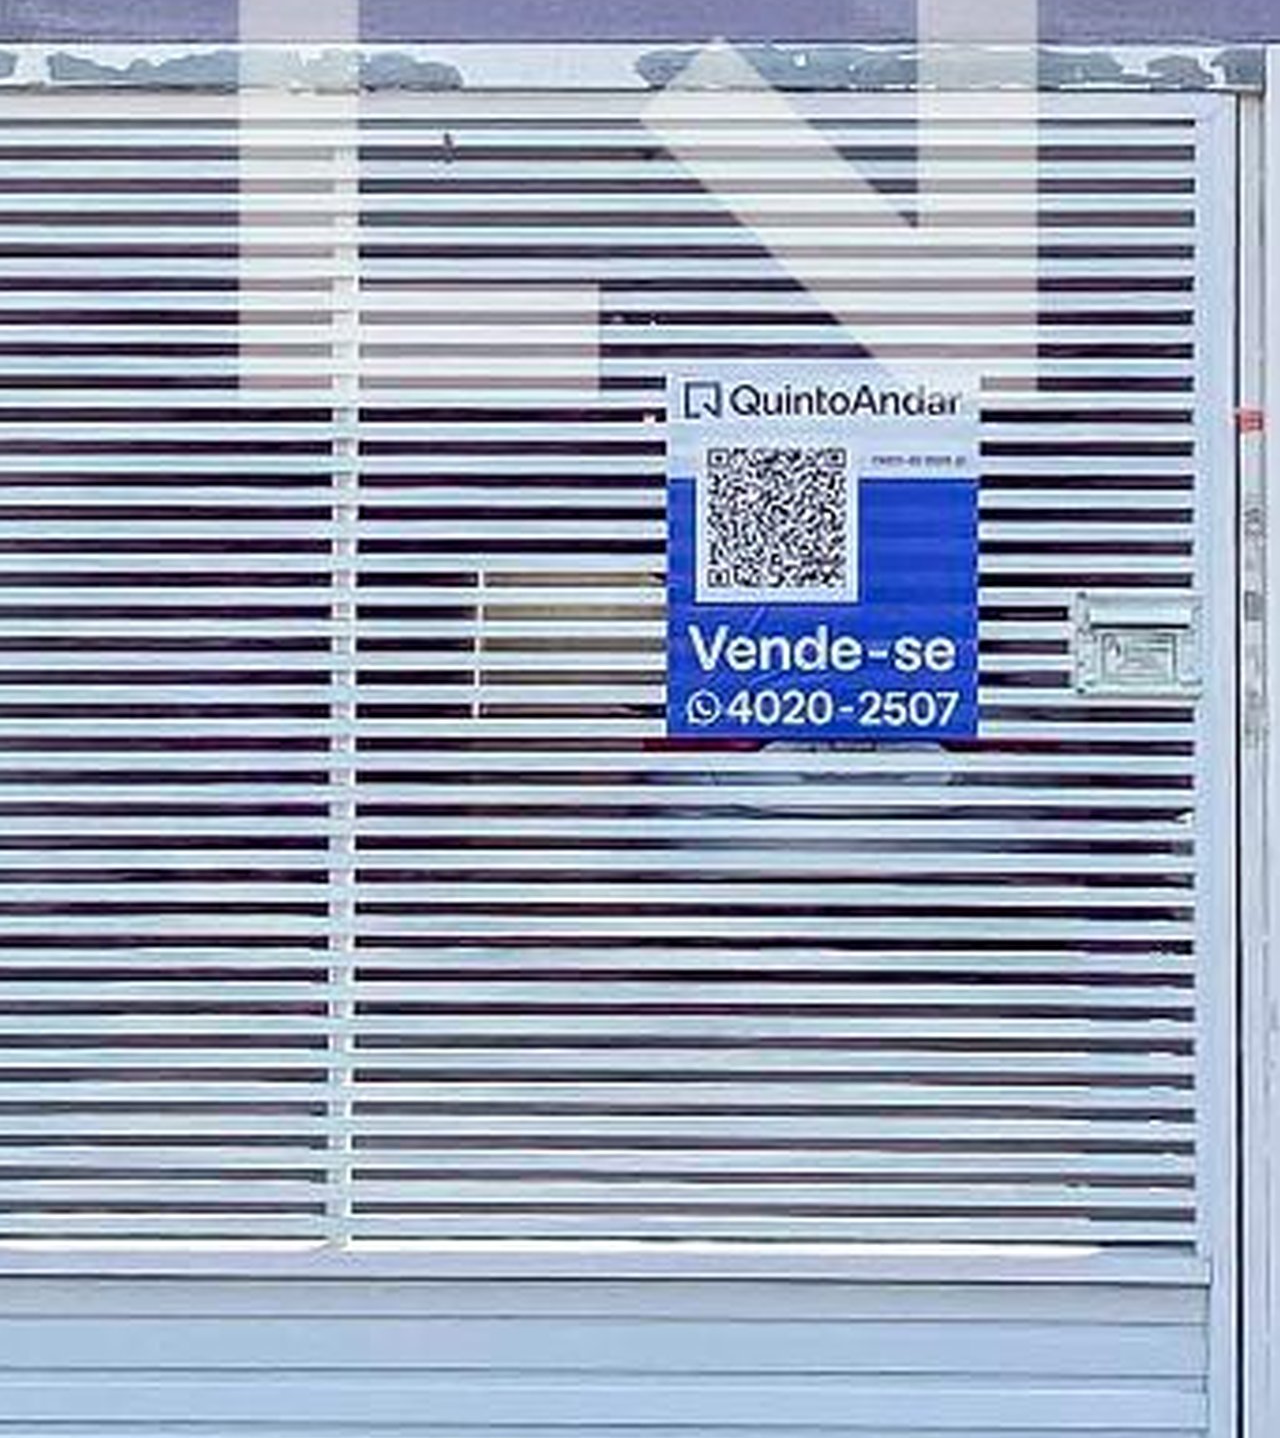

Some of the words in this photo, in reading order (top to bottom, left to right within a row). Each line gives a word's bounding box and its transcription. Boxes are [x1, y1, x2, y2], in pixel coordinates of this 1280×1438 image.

[729, 383, 961, 417] QuintoAndar
[687, 624, 956, 671] Vende-se
[726, 689, 960, 727] 4020-2507
